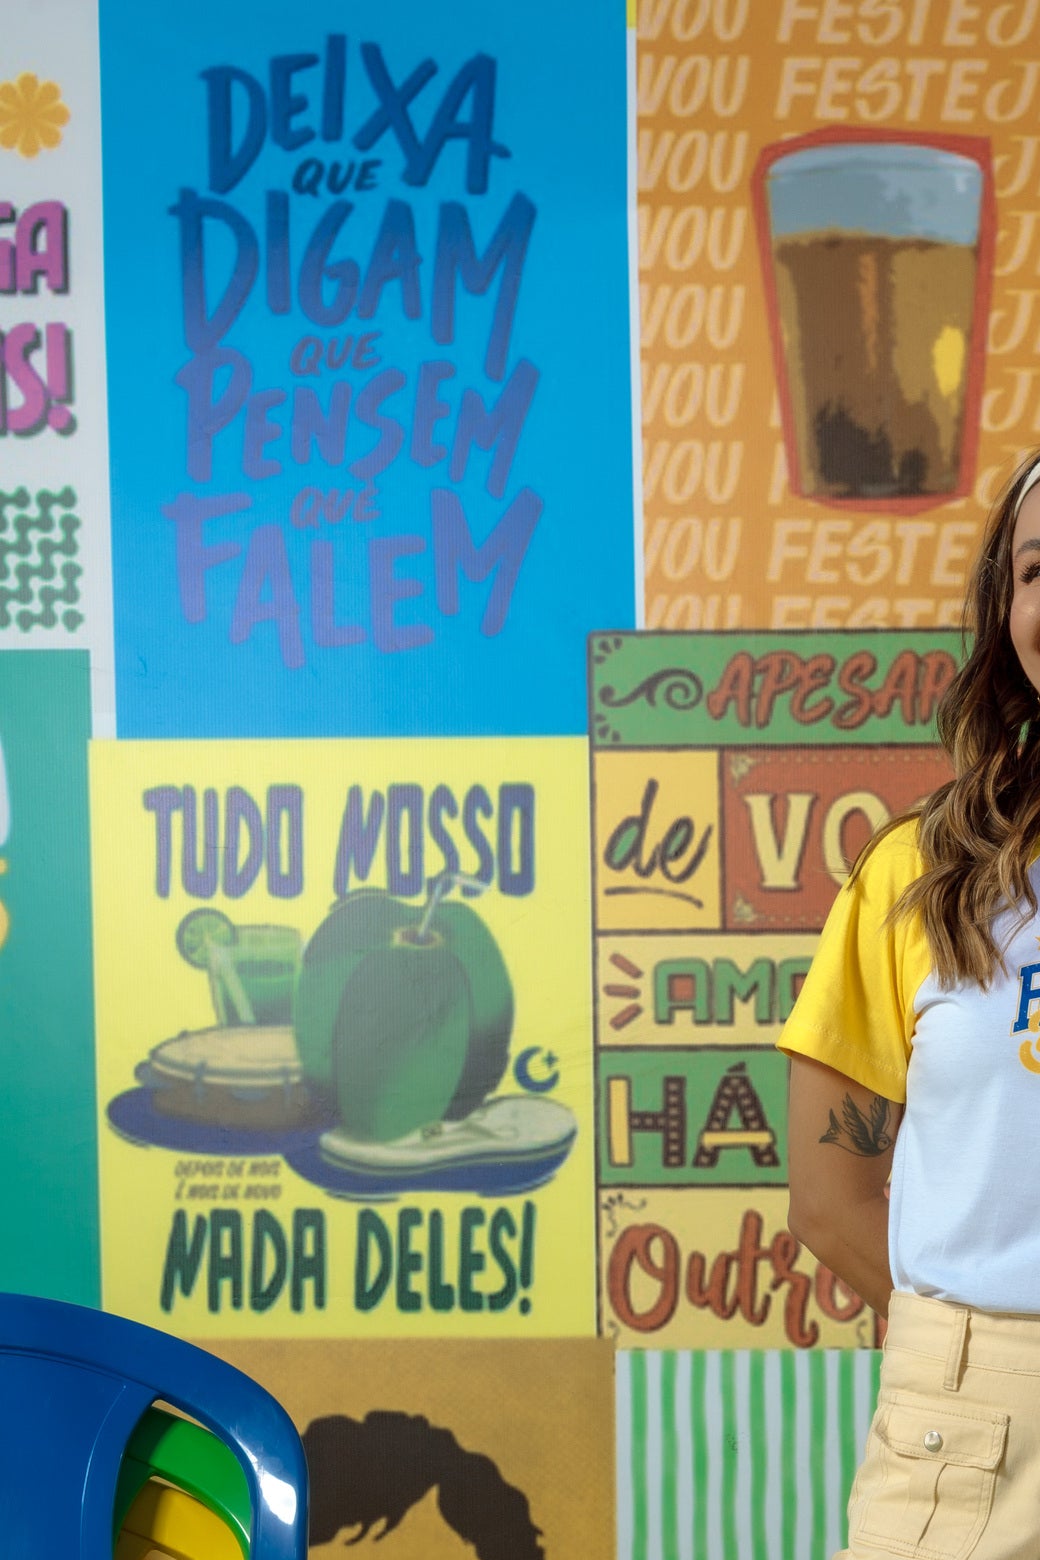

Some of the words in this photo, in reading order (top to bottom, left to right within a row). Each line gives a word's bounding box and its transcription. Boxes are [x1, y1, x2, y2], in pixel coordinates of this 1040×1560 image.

[198, 34, 512, 195] DEIXA
[637, 53, 749, 117] VOU
[291, 157, 382, 197] QUE
[638, 130, 748, 193] VOU
[168, 187, 537, 381] DIGAM
[638, 204, 748, 271] VOU
[289, 331, 382, 377] QUE
[174, 345, 540, 498] PENSEM
[290, 485, 381, 529] QUE
[765, 519, 979, 586] FESTE
[161, 487, 544, 669] FALEM
[142, 783, 304, 900] TUDO
[332, 782, 536, 905] NOSSO
[603, 778, 713, 884] de
[606, 1061, 777, 1168] HÁ
[160, 1207, 327, 1315] NADA
[354, 1200, 538, 1316] DELES!
